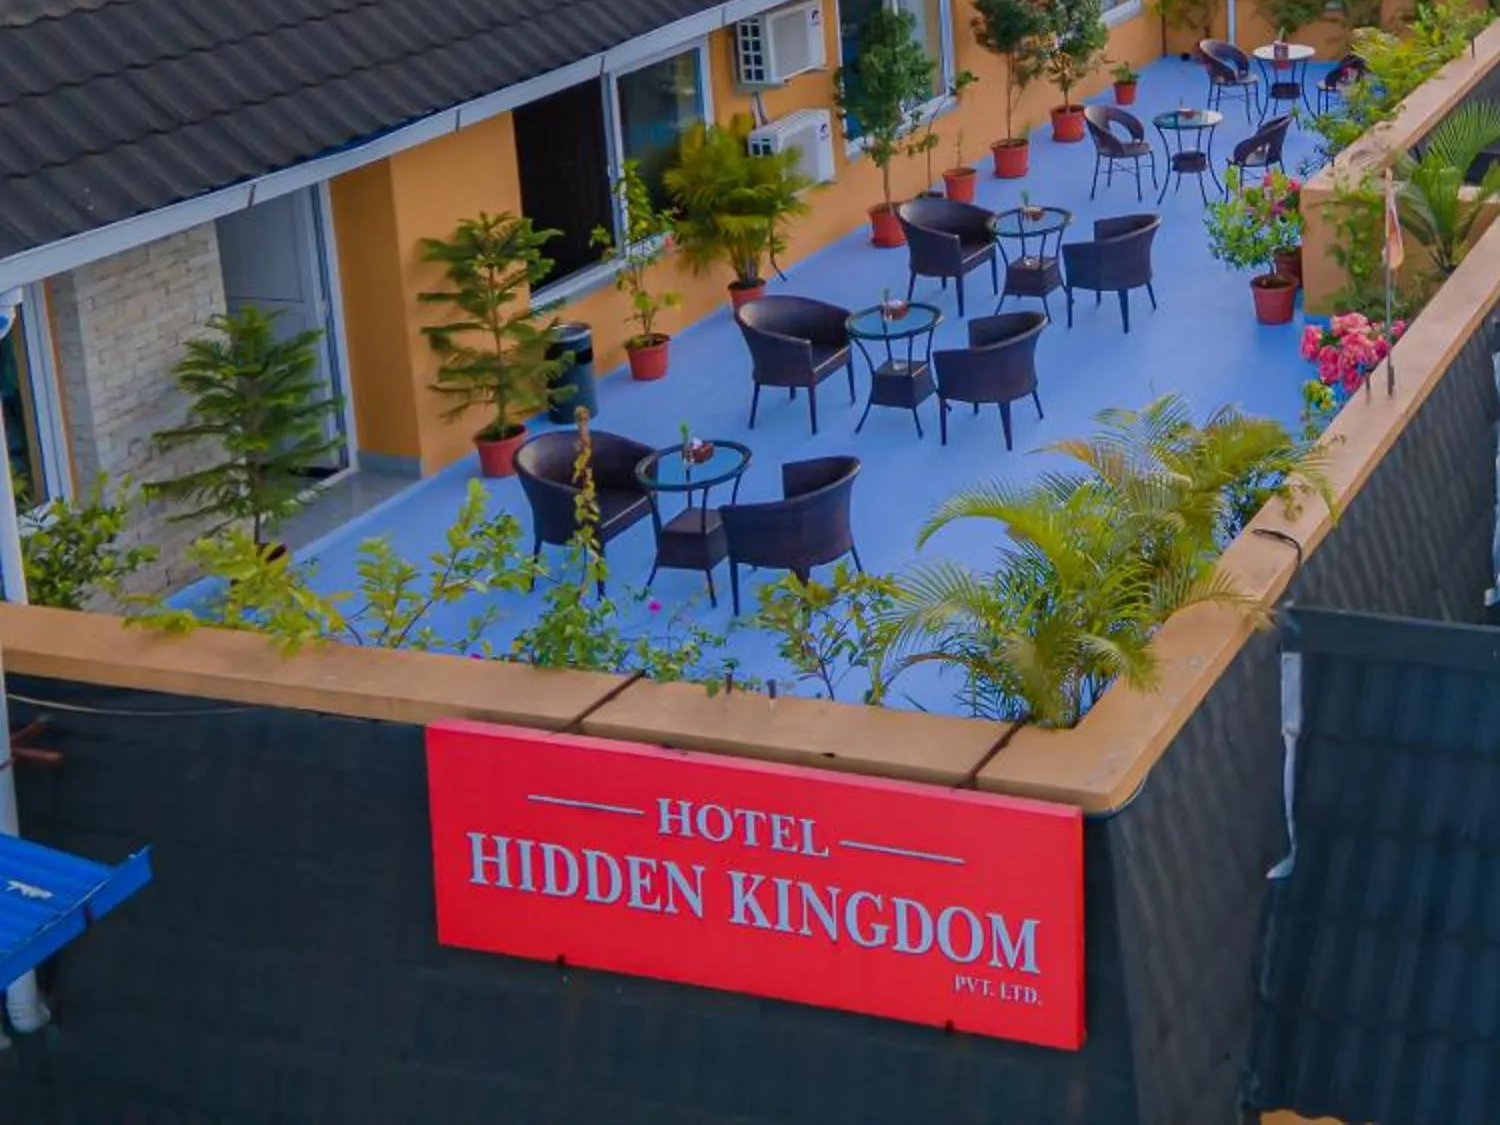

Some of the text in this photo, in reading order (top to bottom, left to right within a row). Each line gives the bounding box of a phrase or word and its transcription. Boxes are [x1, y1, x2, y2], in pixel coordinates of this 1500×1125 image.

[657, 797, 829, 858] HOTEL
[467, 832, 1041, 974] HIDDEN KINGDOM
[954, 975, 1043, 1006] PVT. LTD.
